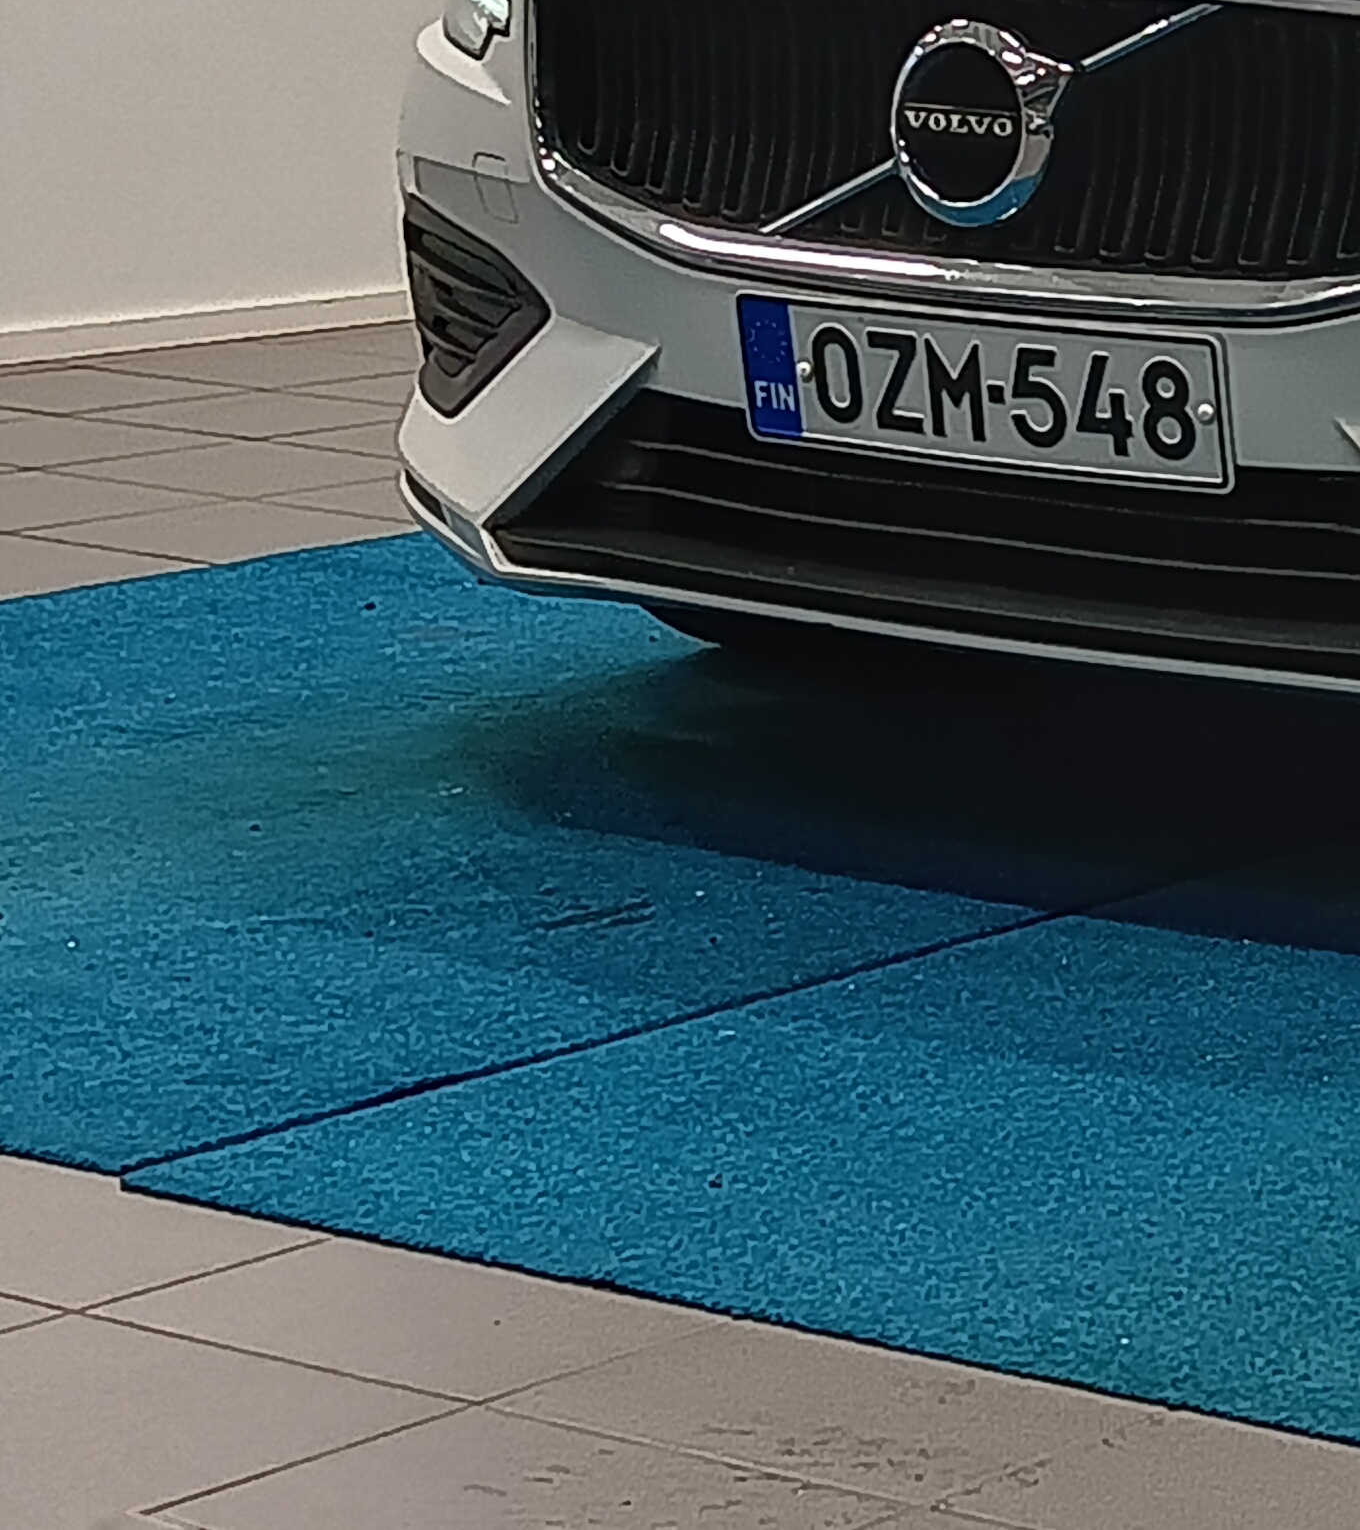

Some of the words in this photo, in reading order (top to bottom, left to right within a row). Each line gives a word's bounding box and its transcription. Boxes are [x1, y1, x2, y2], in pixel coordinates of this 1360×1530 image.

[903, 109, 1013, 137] VOLVO
[754, 380, 796, 412] FIN
[810, 326, 1197, 462] OZM-548
